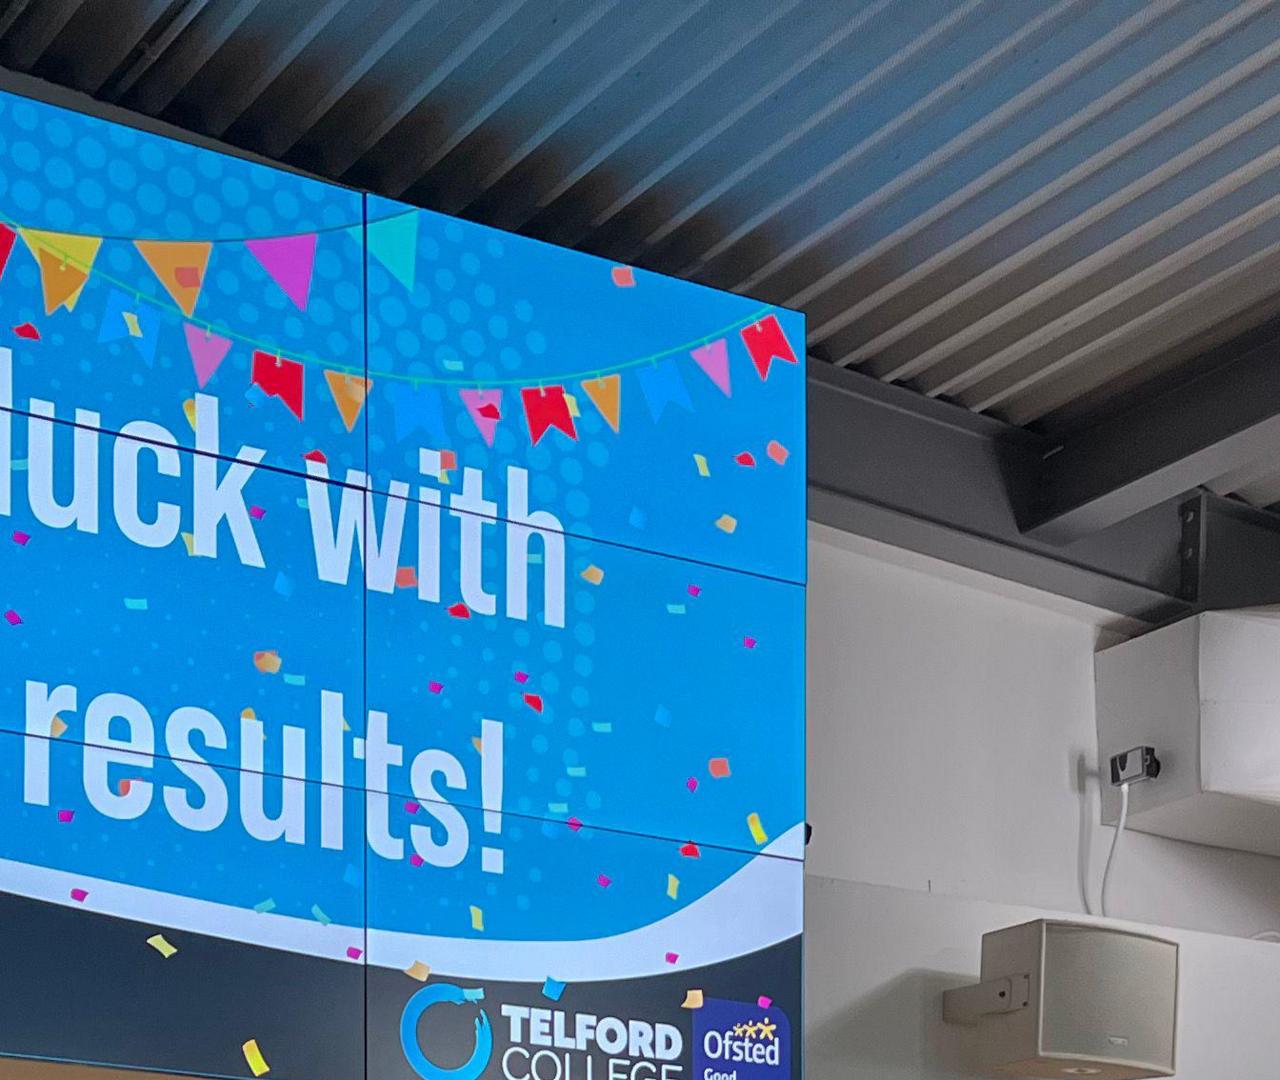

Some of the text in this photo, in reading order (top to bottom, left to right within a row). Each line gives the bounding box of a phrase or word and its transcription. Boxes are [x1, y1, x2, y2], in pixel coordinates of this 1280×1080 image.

[305, 446, 568, 629] with
[23, 689, 505, 875] results!
[501, 1003, 684, 1060] TELFORD
[703, 1030, 780, 1066] Ofsted
